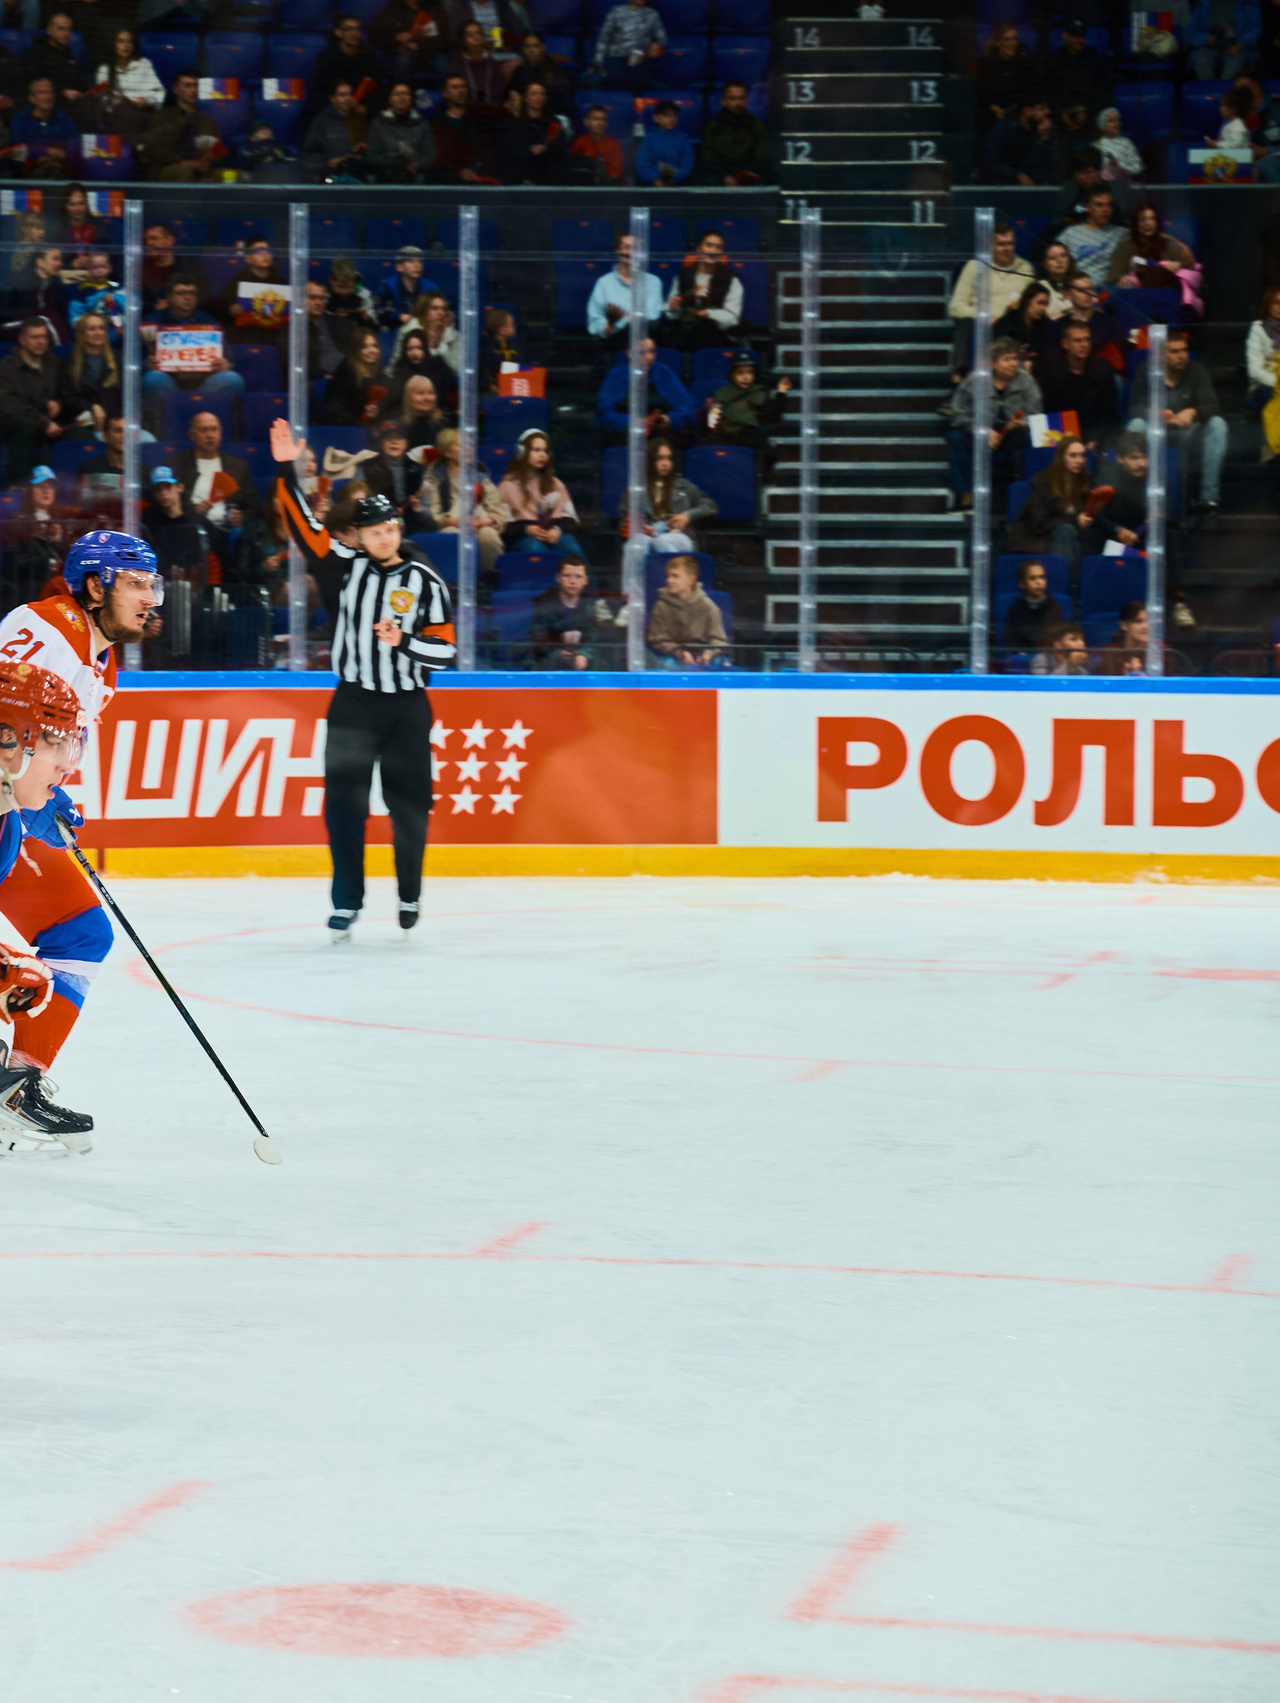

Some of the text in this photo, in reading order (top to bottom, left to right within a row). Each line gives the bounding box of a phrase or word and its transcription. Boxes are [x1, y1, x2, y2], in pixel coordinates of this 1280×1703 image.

[794, 28, 819, 47] 14
[907, 27, 934, 47] 14
[787, 81, 815, 102] 13
[910, 81, 937, 102] 13
[785, 141, 812, 162] 12
[909, 141, 936, 161] 12
[912, 201, 934, 224] 11
[0, 628, 45, 662] 21
[57, 717, 391, 820] АШИН
[816, 714, 1280, 828] РОЛЬ
